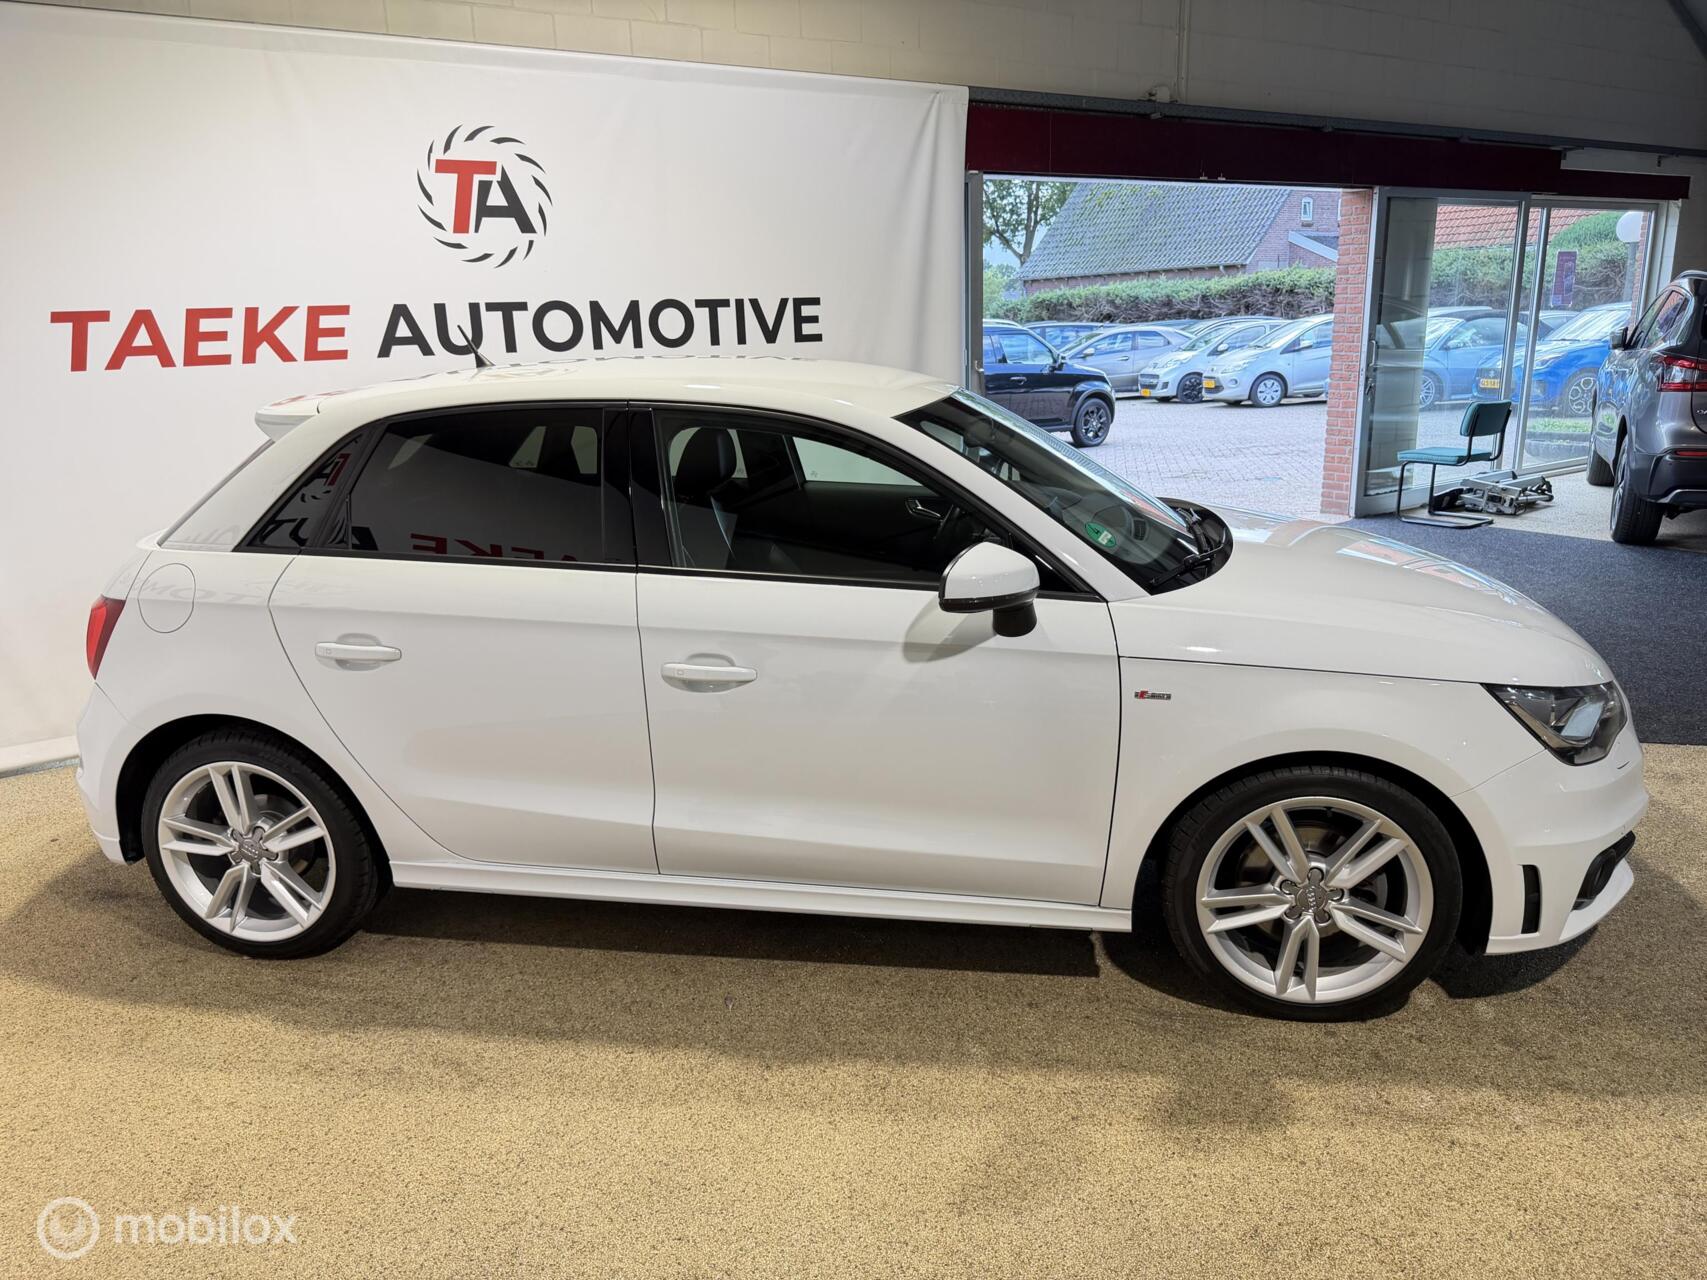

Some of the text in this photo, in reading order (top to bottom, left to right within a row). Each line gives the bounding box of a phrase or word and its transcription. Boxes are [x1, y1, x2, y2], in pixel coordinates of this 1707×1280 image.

[435, 159, 537, 234] TA
[51, 296, 823, 372] TAEKE AUTOMOTIVE
